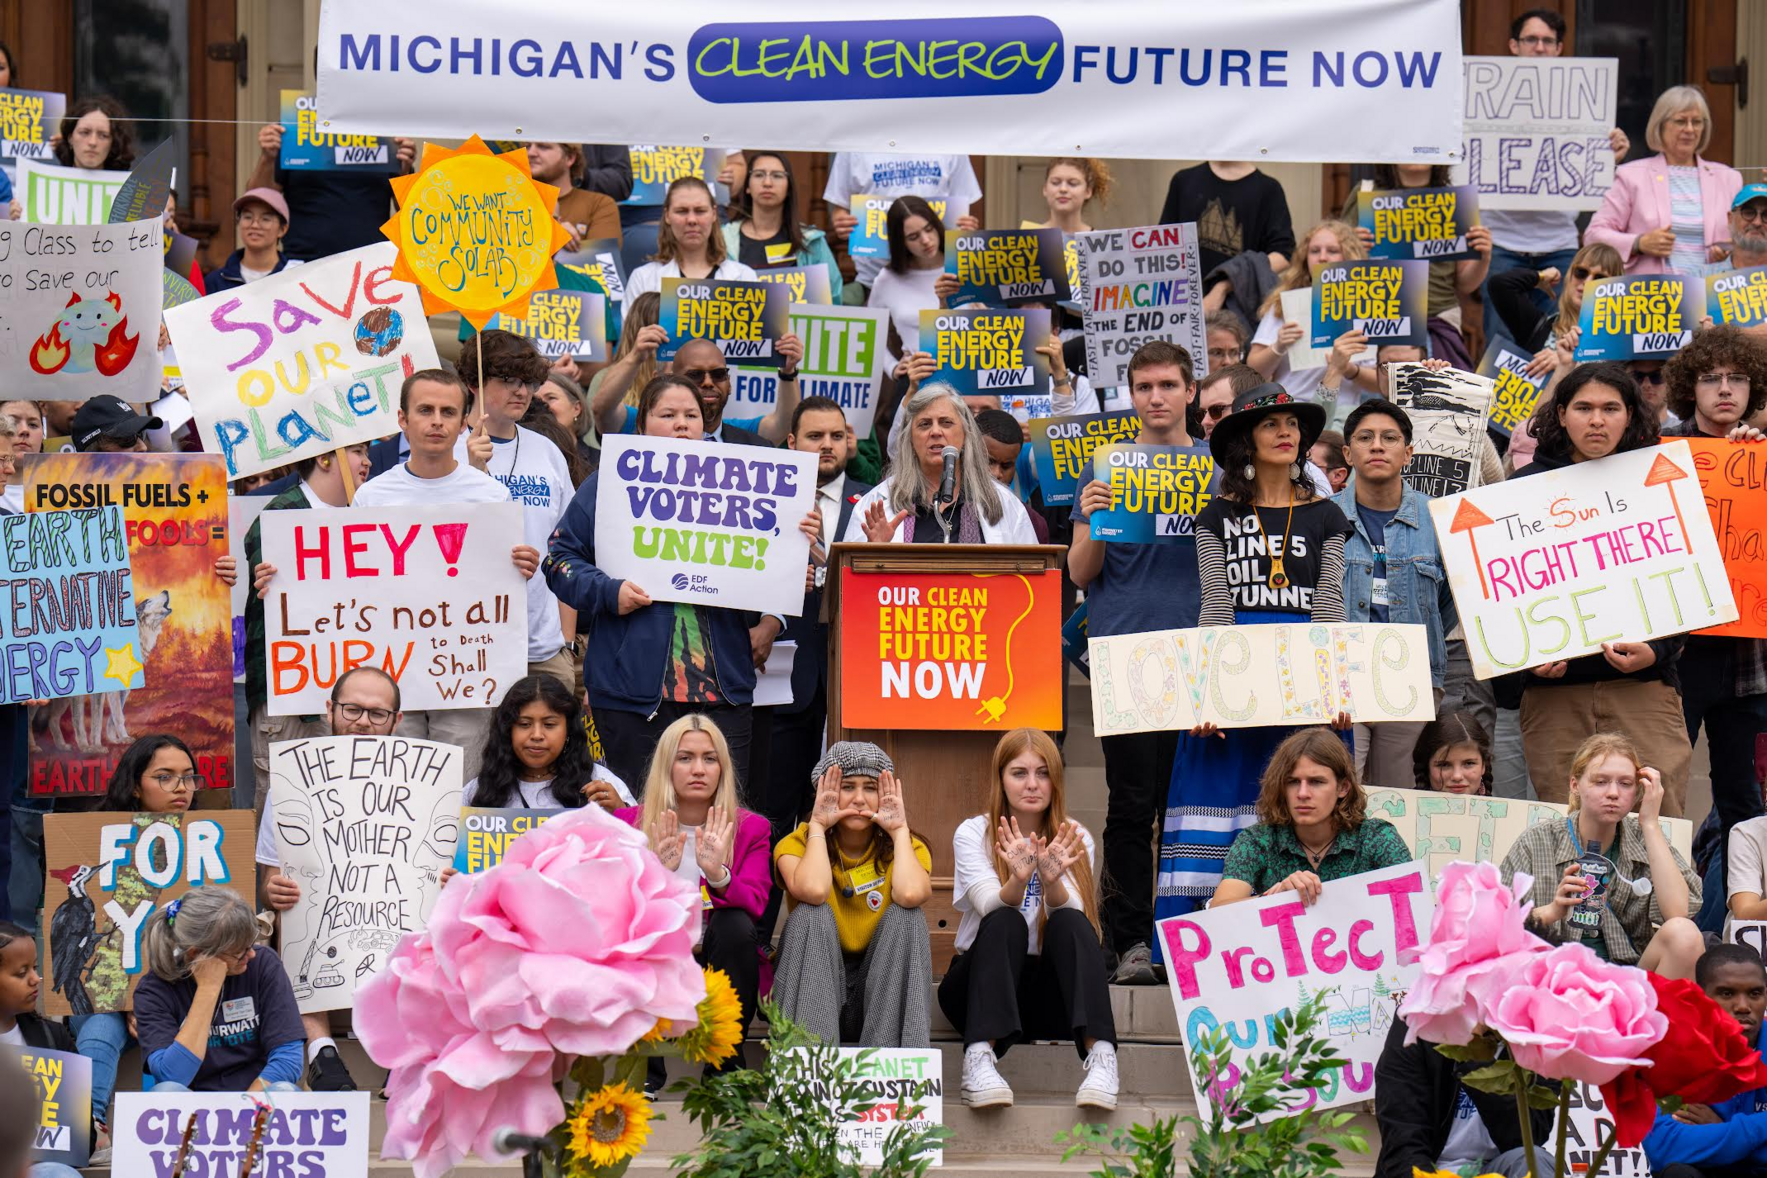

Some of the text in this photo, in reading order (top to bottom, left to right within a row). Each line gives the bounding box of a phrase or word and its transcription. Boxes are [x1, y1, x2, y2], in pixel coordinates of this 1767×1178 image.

[339, 33, 1443, 89] MICHIGAN'S CLEAN ENERGY FUTURE NOW
[1462, 61, 1609, 122] RAIN
[296, 97, 317, 111] OU
[9, 142, 46, 157] NOW
[342, 146, 382, 163] NOW
[630, 151, 704, 170] ENERGY
[1462, 137, 1614, 198] LEASE
[918, 176, 939, 186] NOW
[447, 191, 508, 211] WE WANT
[866, 200, 893, 211] OU
[1372, 192, 1457, 210] OUR CLEAN
[1374, 206, 1457, 227] ENERGY
[24, 227, 78, 256] Class
[92, 230, 114, 253] to
[128, 225, 158, 251] tell
[956, 235, 1039, 251] OUR CLEAN
[1085, 227, 1179, 253] WE CAN
[1375, 222, 1457, 244] FUTURE
[1421, 237, 1460, 256] NOW
[957, 249, 1039, 270] ENERGY
[1098, 253, 1187, 278] DO THIS!
[85, 269, 119, 288] our
[600, 259, 624, 294] NOW
[958, 266, 1044, 287] FUTURE
[1078, 249, 1092, 301] FOREVER
[1321, 266, 1403, 283] OUR CLEAN
[1713, 275, 1748, 293] OUR
[676, 284, 766, 303] OUR CLEAN
[1009, 280, 1046, 297] NOW
[1093, 278, 1189, 312] IMAGINE
[1321, 280, 1403, 303] ENERGY
[1594, 281, 1684, 297] OUR CLEAN
[532, 293, 582, 310] CLEAN
[677, 298, 766, 322] ENERGY
[1186, 250, 1205, 374] FAST FAIR FOREVER
[1320, 299, 1401, 322] FUTURE
[1593, 294, 1682, 316] ENERGY
[498, 320, 581, 344] FUTURE
[676, 317, 764, 342] FUTURE
[935, 316, 1025, 331] OUR CLEAN
[1084, 308, 1096, 337] FAIR
[1093, 311, 1188, 334] THE END OF
[1361, 317, 1404, 336] NOW
[1592, 313, 1682, 336] FUTURE
[545, 340, 583, 355] NOW
[723, 339, 767, 357] NOW
[789, 317, 868, 374] NITE
[937, 330, 1025, 351] ENERGY
[1642, 331, 1685, 351] NOW
[936, 350, 1024, 370] FUTURE
[237, 341, 351, 408] OUR
[985, 367, 1027, 387] NOW
[736, 375, 777, 404] FOR
[1046, 416, 1143, 440] OUR CLEAN
[617, 448, 799, 498] CLIMATE
[1108, 451, 1149, 469] OUR
[1153, 453, 1214, 473] CLEAN
[1417, 456, 1465, 480] LINE 5
[1109, 467, 1214, 493] ENERGY
[36, 483, 117, 507] FOSSIL
[122, 483, 191, 507] FUELS
[523, 496, 551, 508] NOW
[1109, 488, 1213, 516] FUTURE
[626, 486, 781, 537] VOTERS,
[1496, 491, 1628, 541] The Sun Is
[1165, 514, 1197, 535] NO
[1223, 515, 1261, 540] NO
[4, 506, 125, 573] EARTH
[633, 525, 770, 572] UNITE!
[1226, 534, 1308, 562] LINE 5
[295, 523, 469, 581] HEY!
[1487, 540, 1579, 602] RIGHT
[1582, 515, 1684, 571] THERE
[691, 574, 708, 585] EDF
[1226, 559, 1267, 587] OIL
[689, 583, 719, 595] Action
[878, 586, 988, 606] OUR CLEAN
[1229, 584, 1316, 611] TUNNE
[0, 567, 136, 639] ERNATIVE
[280, 592, 510, 637] Let's not all
[1474, 585, 1624, 668] USE
[1632, 562, 1716, 635] IT!
[879, 606, 988, 633] ENERGY
[431, 633, 494, 650] to Death
[879, 633, 988, 661] FUTURE
[0, 635, 102, 701] ERGY
[428, 649, 487, 677] Shall
[436, 678, 498, 706] We?
[881, 660, 987, 700] NOW
[279, 737, 451, 789] THE EARTH
[311, 781, 416, 825] IS OUR
[465, 815, 508, 833] OUR
[322, 818, 412, 864] MOTHER
[1006, 843, 1027, 861] OUR
[99, 819, 232, 892] FOR
[328, 860, 402, 896] NOT A
[316, 894, 413, 940] RESOURCE
[136, 1108, 348, 1147] CLIMATE
[853, 1127, 883, 1139] THE
